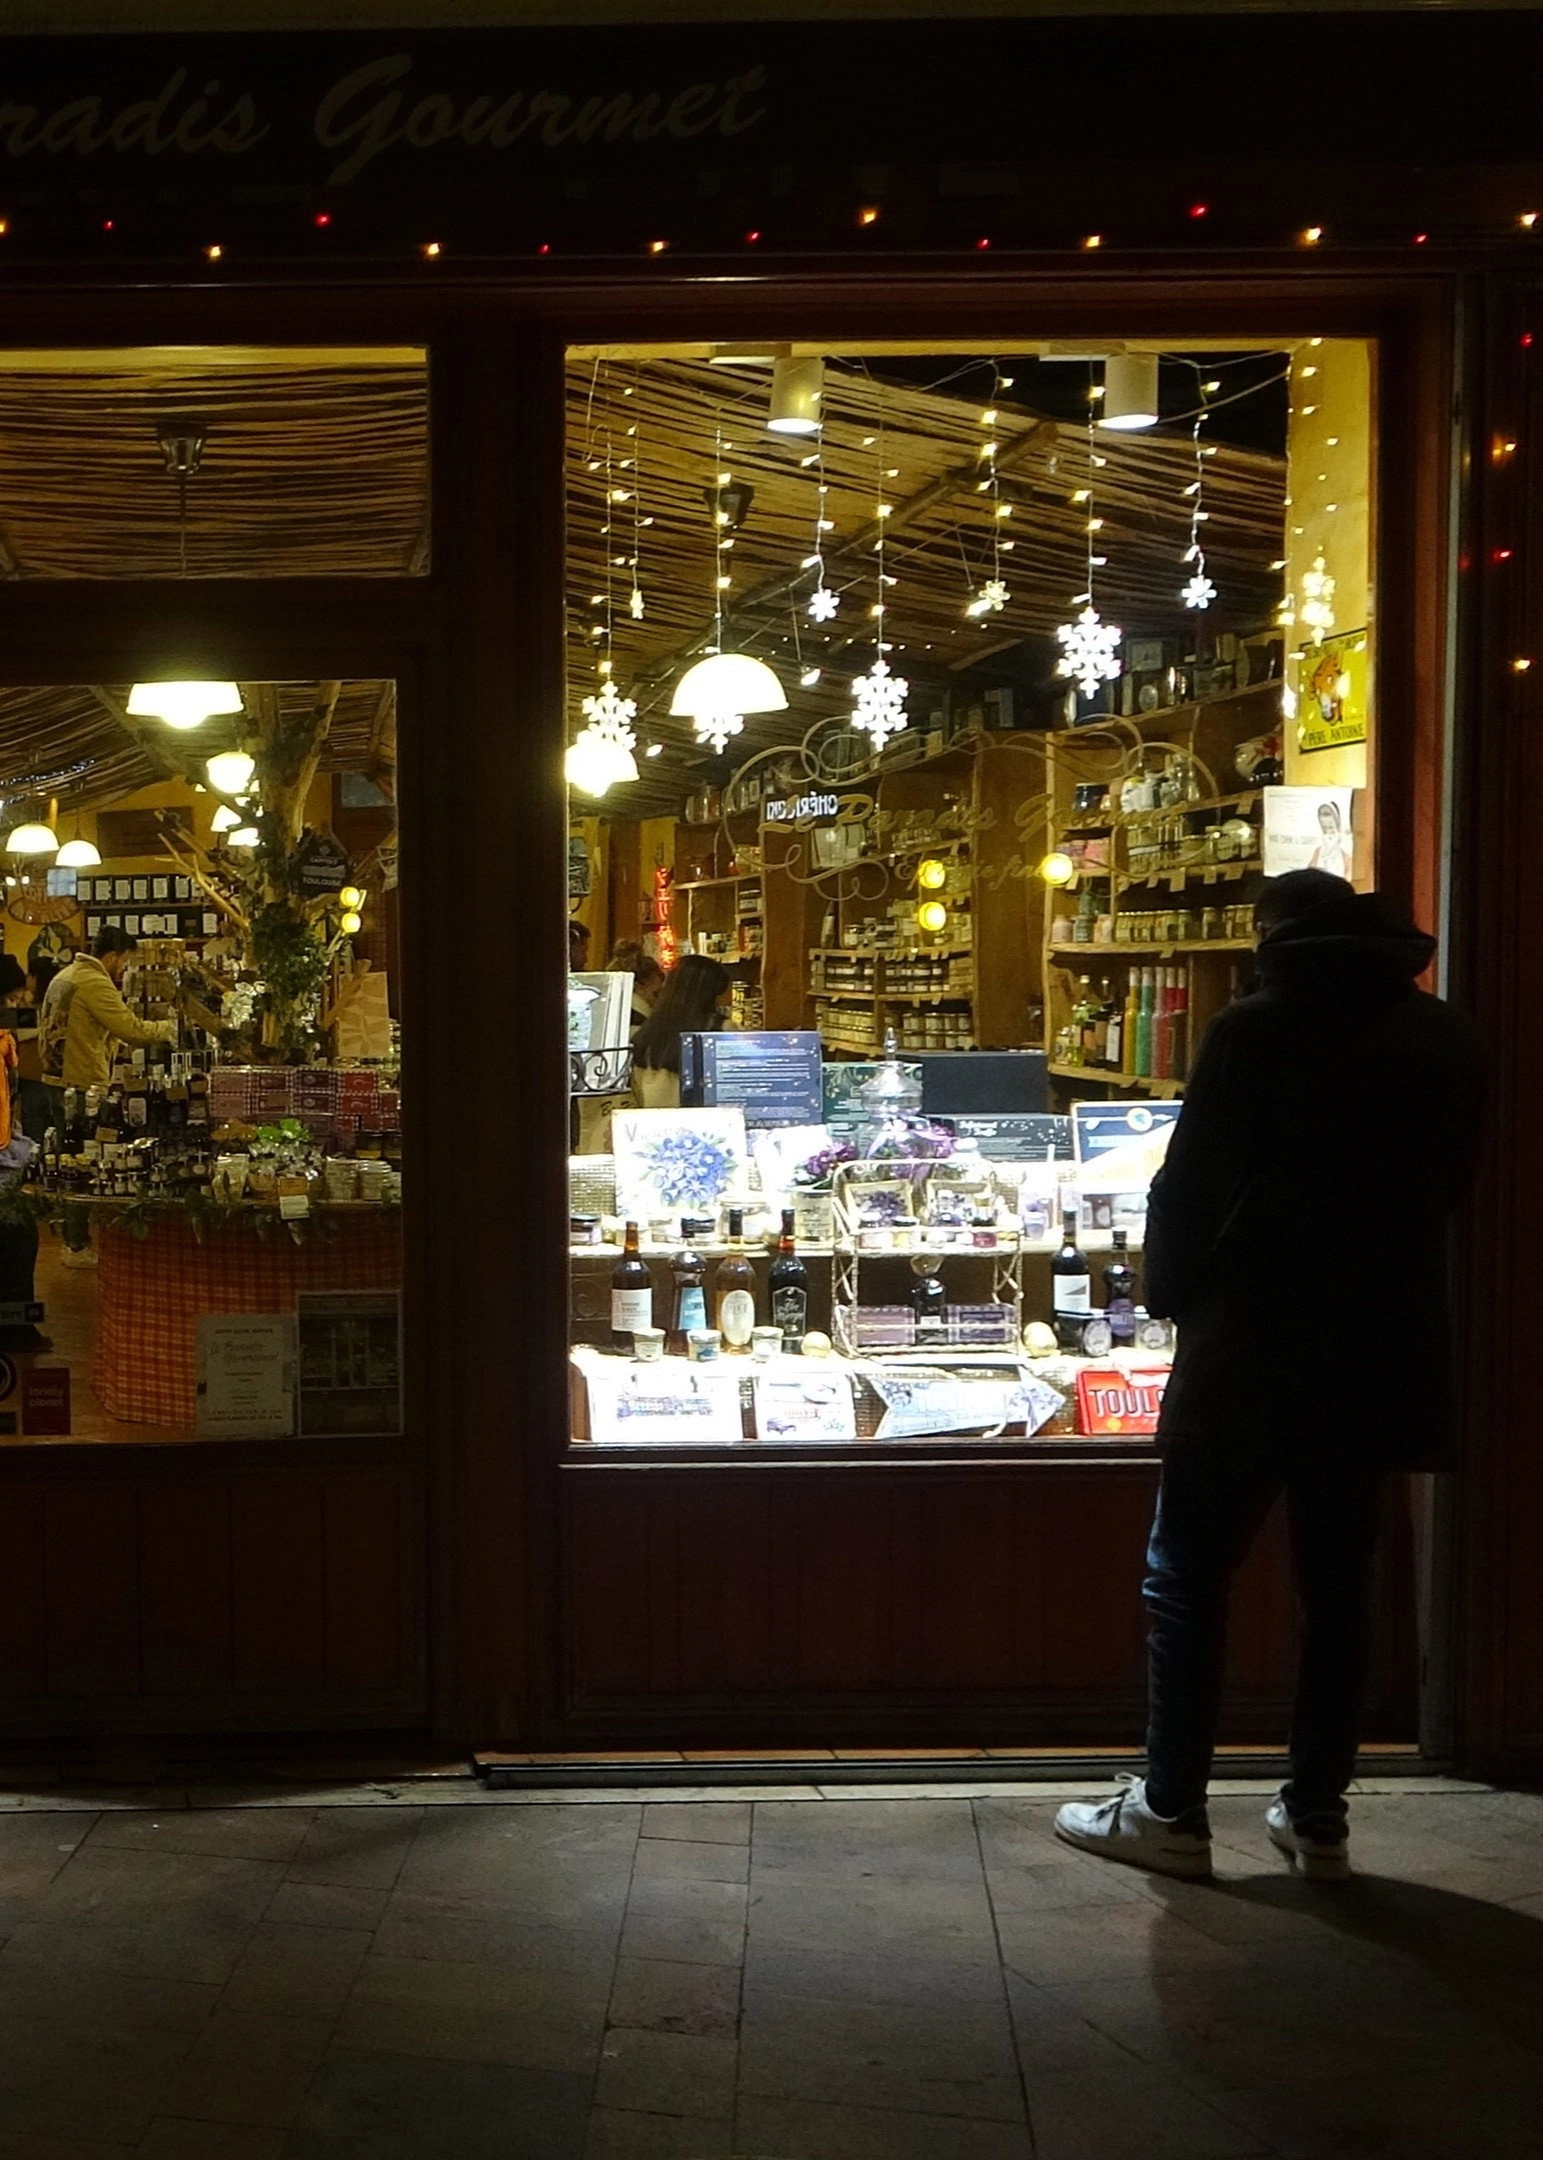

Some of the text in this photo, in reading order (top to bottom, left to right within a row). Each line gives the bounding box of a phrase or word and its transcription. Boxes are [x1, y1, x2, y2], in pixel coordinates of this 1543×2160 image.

[313, 53, 767, 187] Gourmet
[757, 794, 817, 834] Le
[29, 1386, 63, 1398] lonely
[29, 1398, 64, 1408] planet
